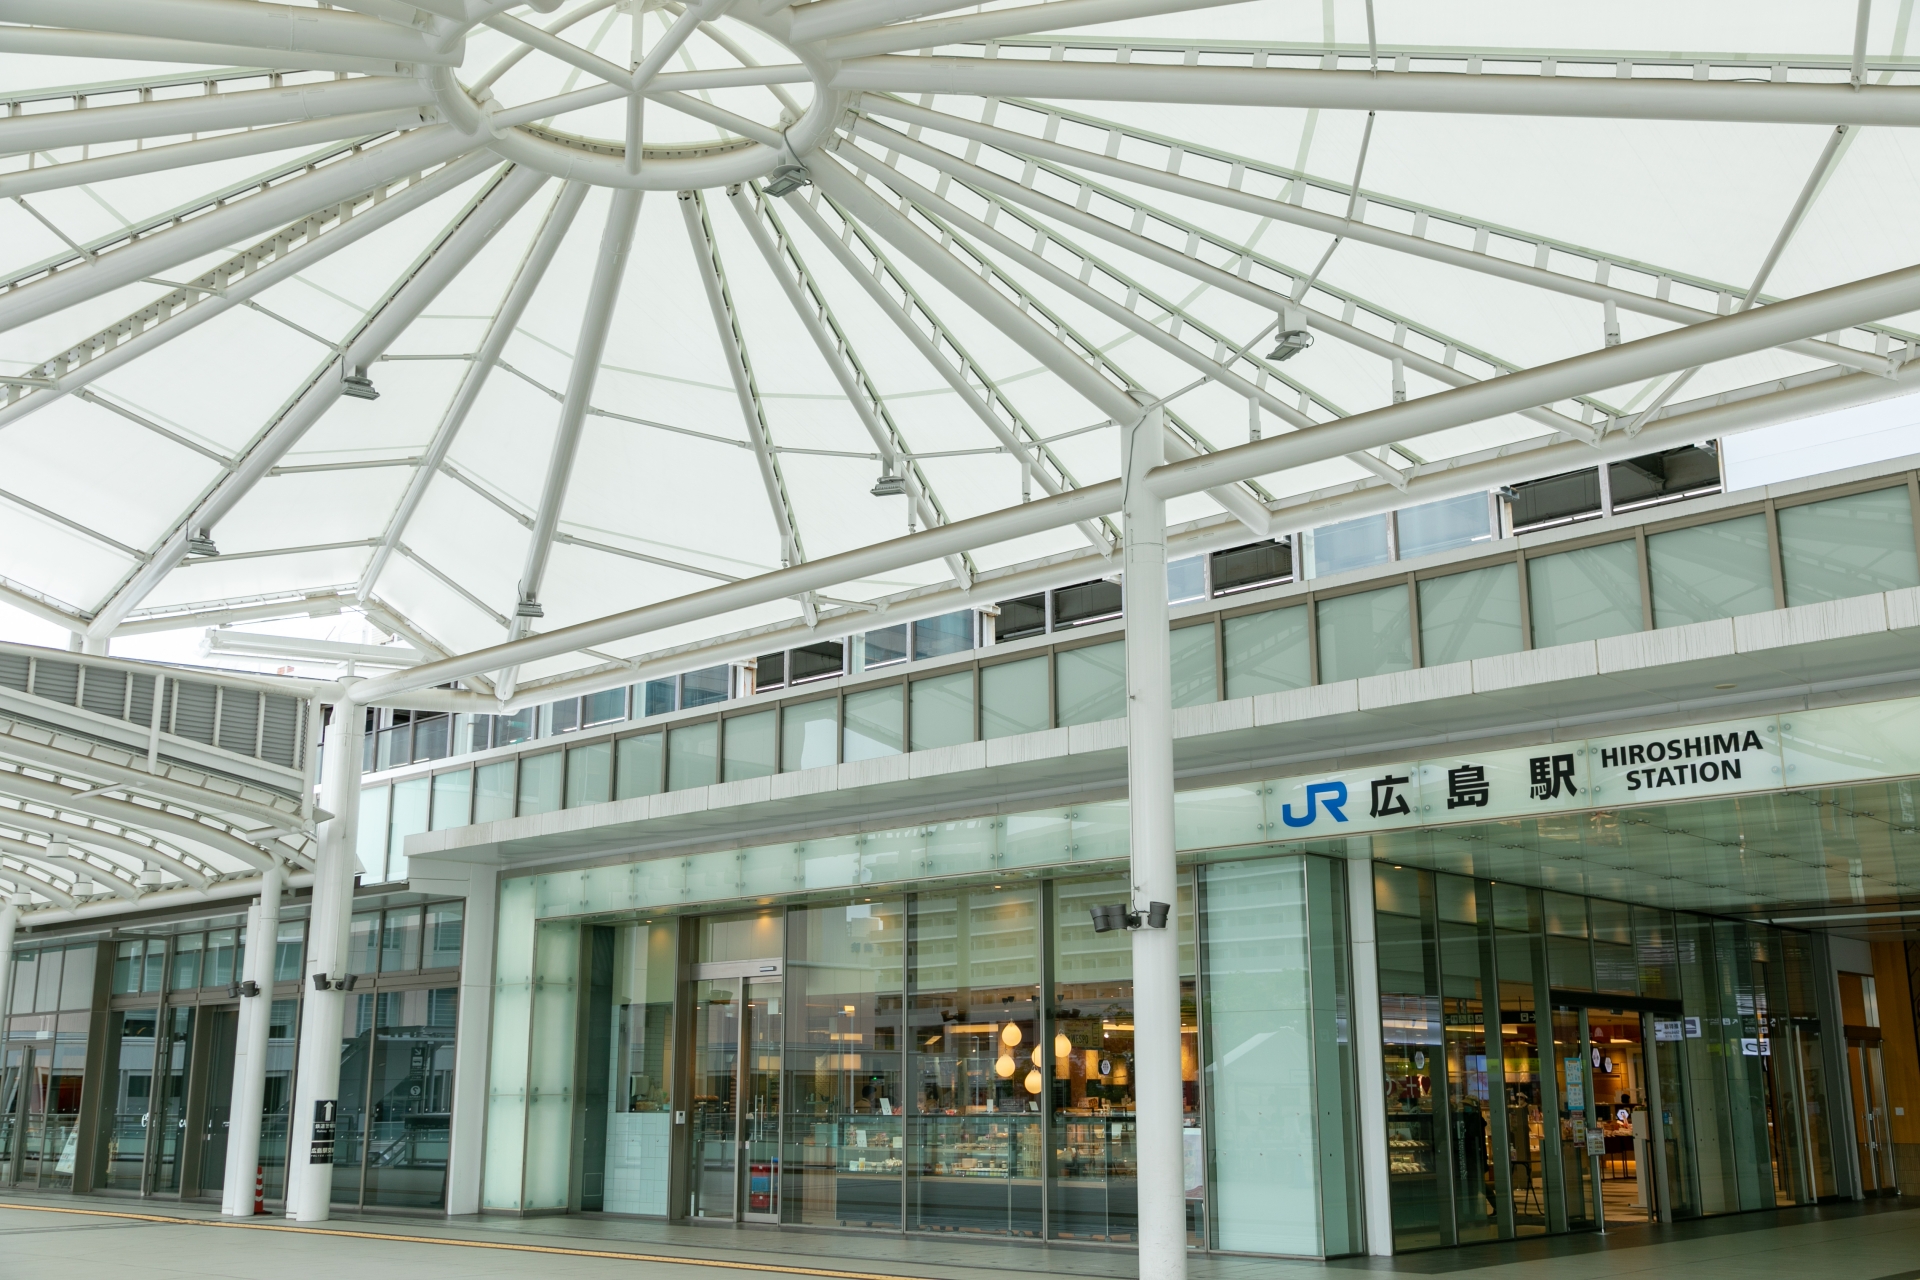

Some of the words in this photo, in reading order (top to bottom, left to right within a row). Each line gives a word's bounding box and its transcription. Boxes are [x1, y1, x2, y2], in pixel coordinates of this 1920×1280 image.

[1601, 729, 1763, 768] HIROSHIMA
[1282, 780, 1349, 828] JR
[1369, 753, 1578, 819] 広島駅
[1626, 758, 1742, 791] STATION
